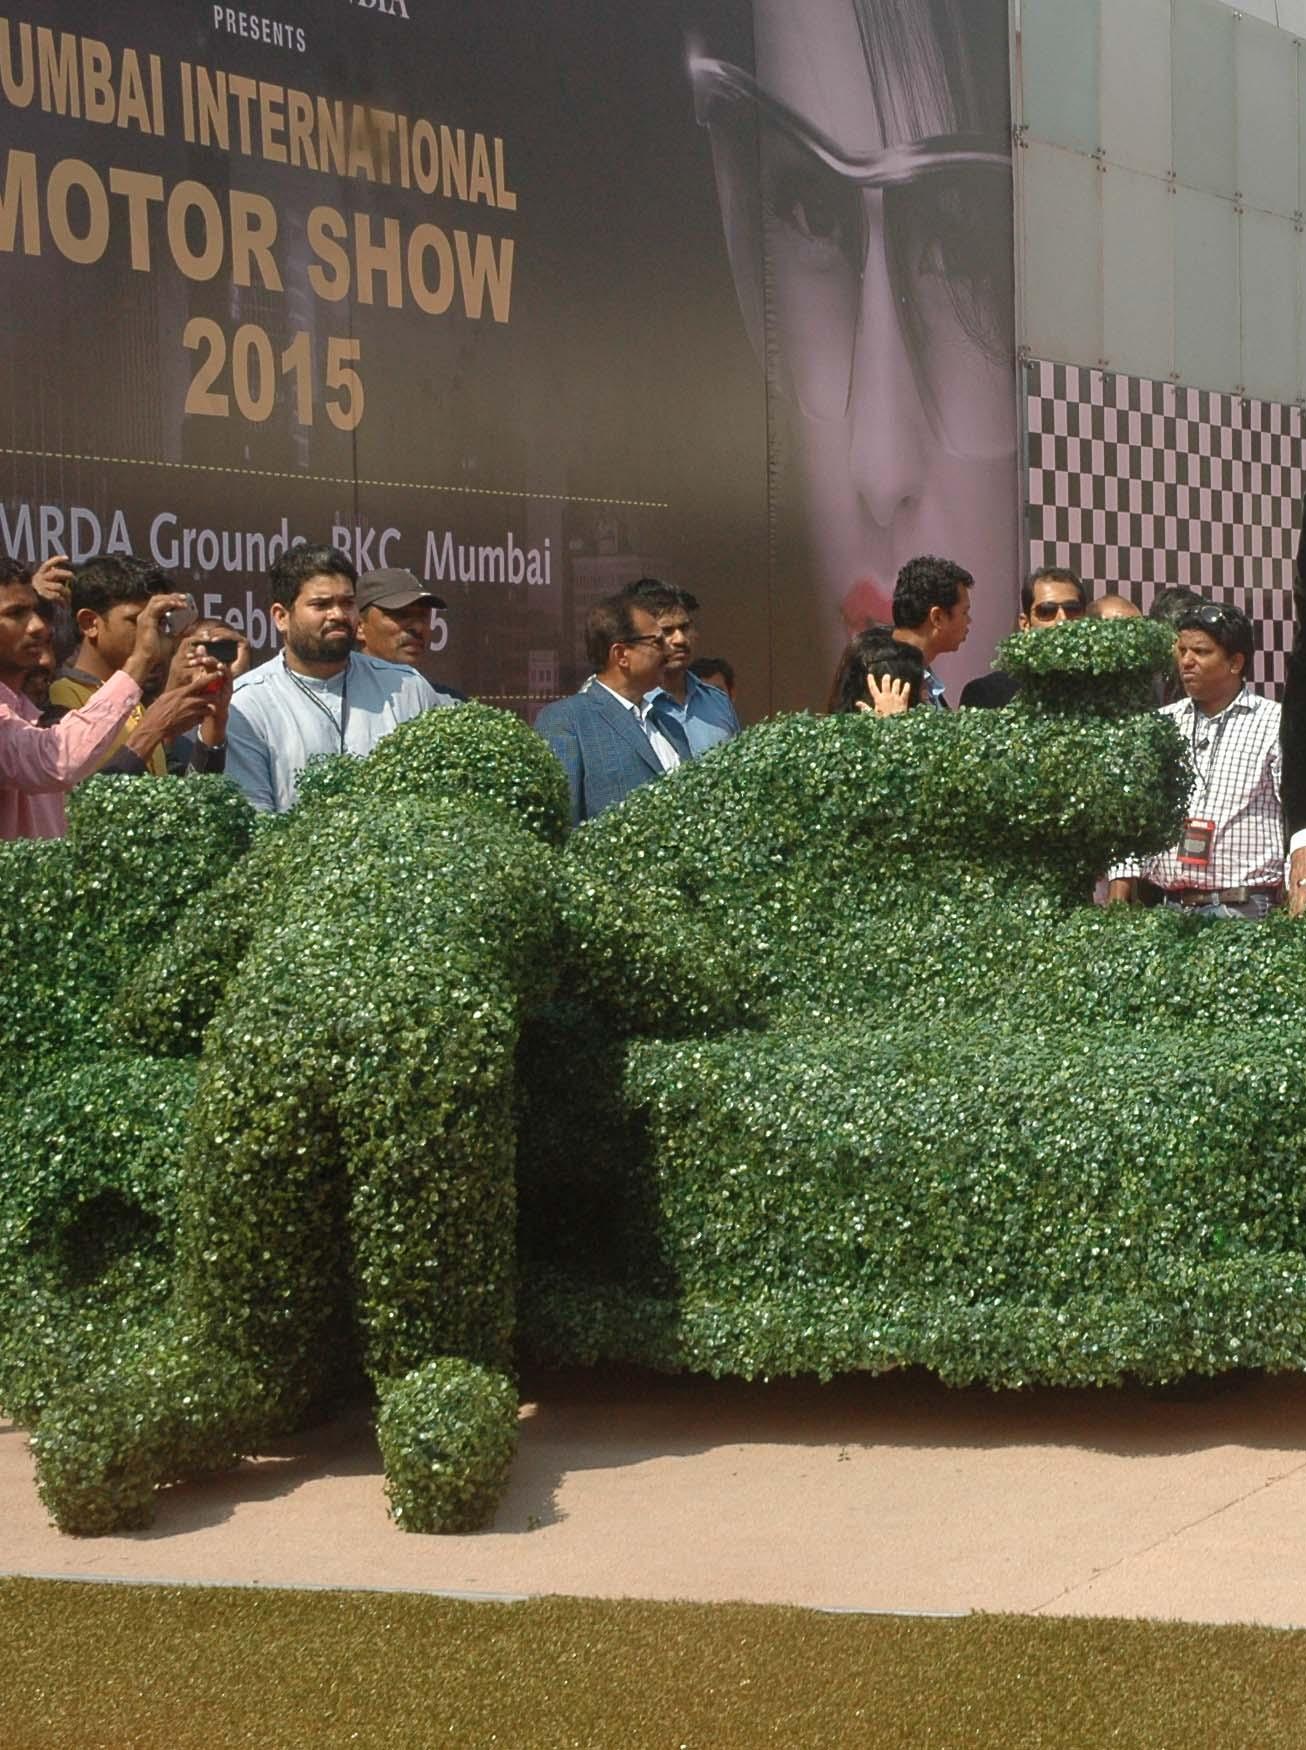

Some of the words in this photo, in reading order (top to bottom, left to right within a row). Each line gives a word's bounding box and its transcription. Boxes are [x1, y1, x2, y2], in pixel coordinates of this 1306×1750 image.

[213, 5, 306, 52] PRESENTS
[181, 61, 517, 210] INTERNATIONAL
[0, 149, 283, 292] MOTOR
[307, 206, 515, 323] SHOW
[183, 317, 364, 431] 2015
[150, 512, 307, 573] Ground
[424, 530, 551, 585] Mumbai
